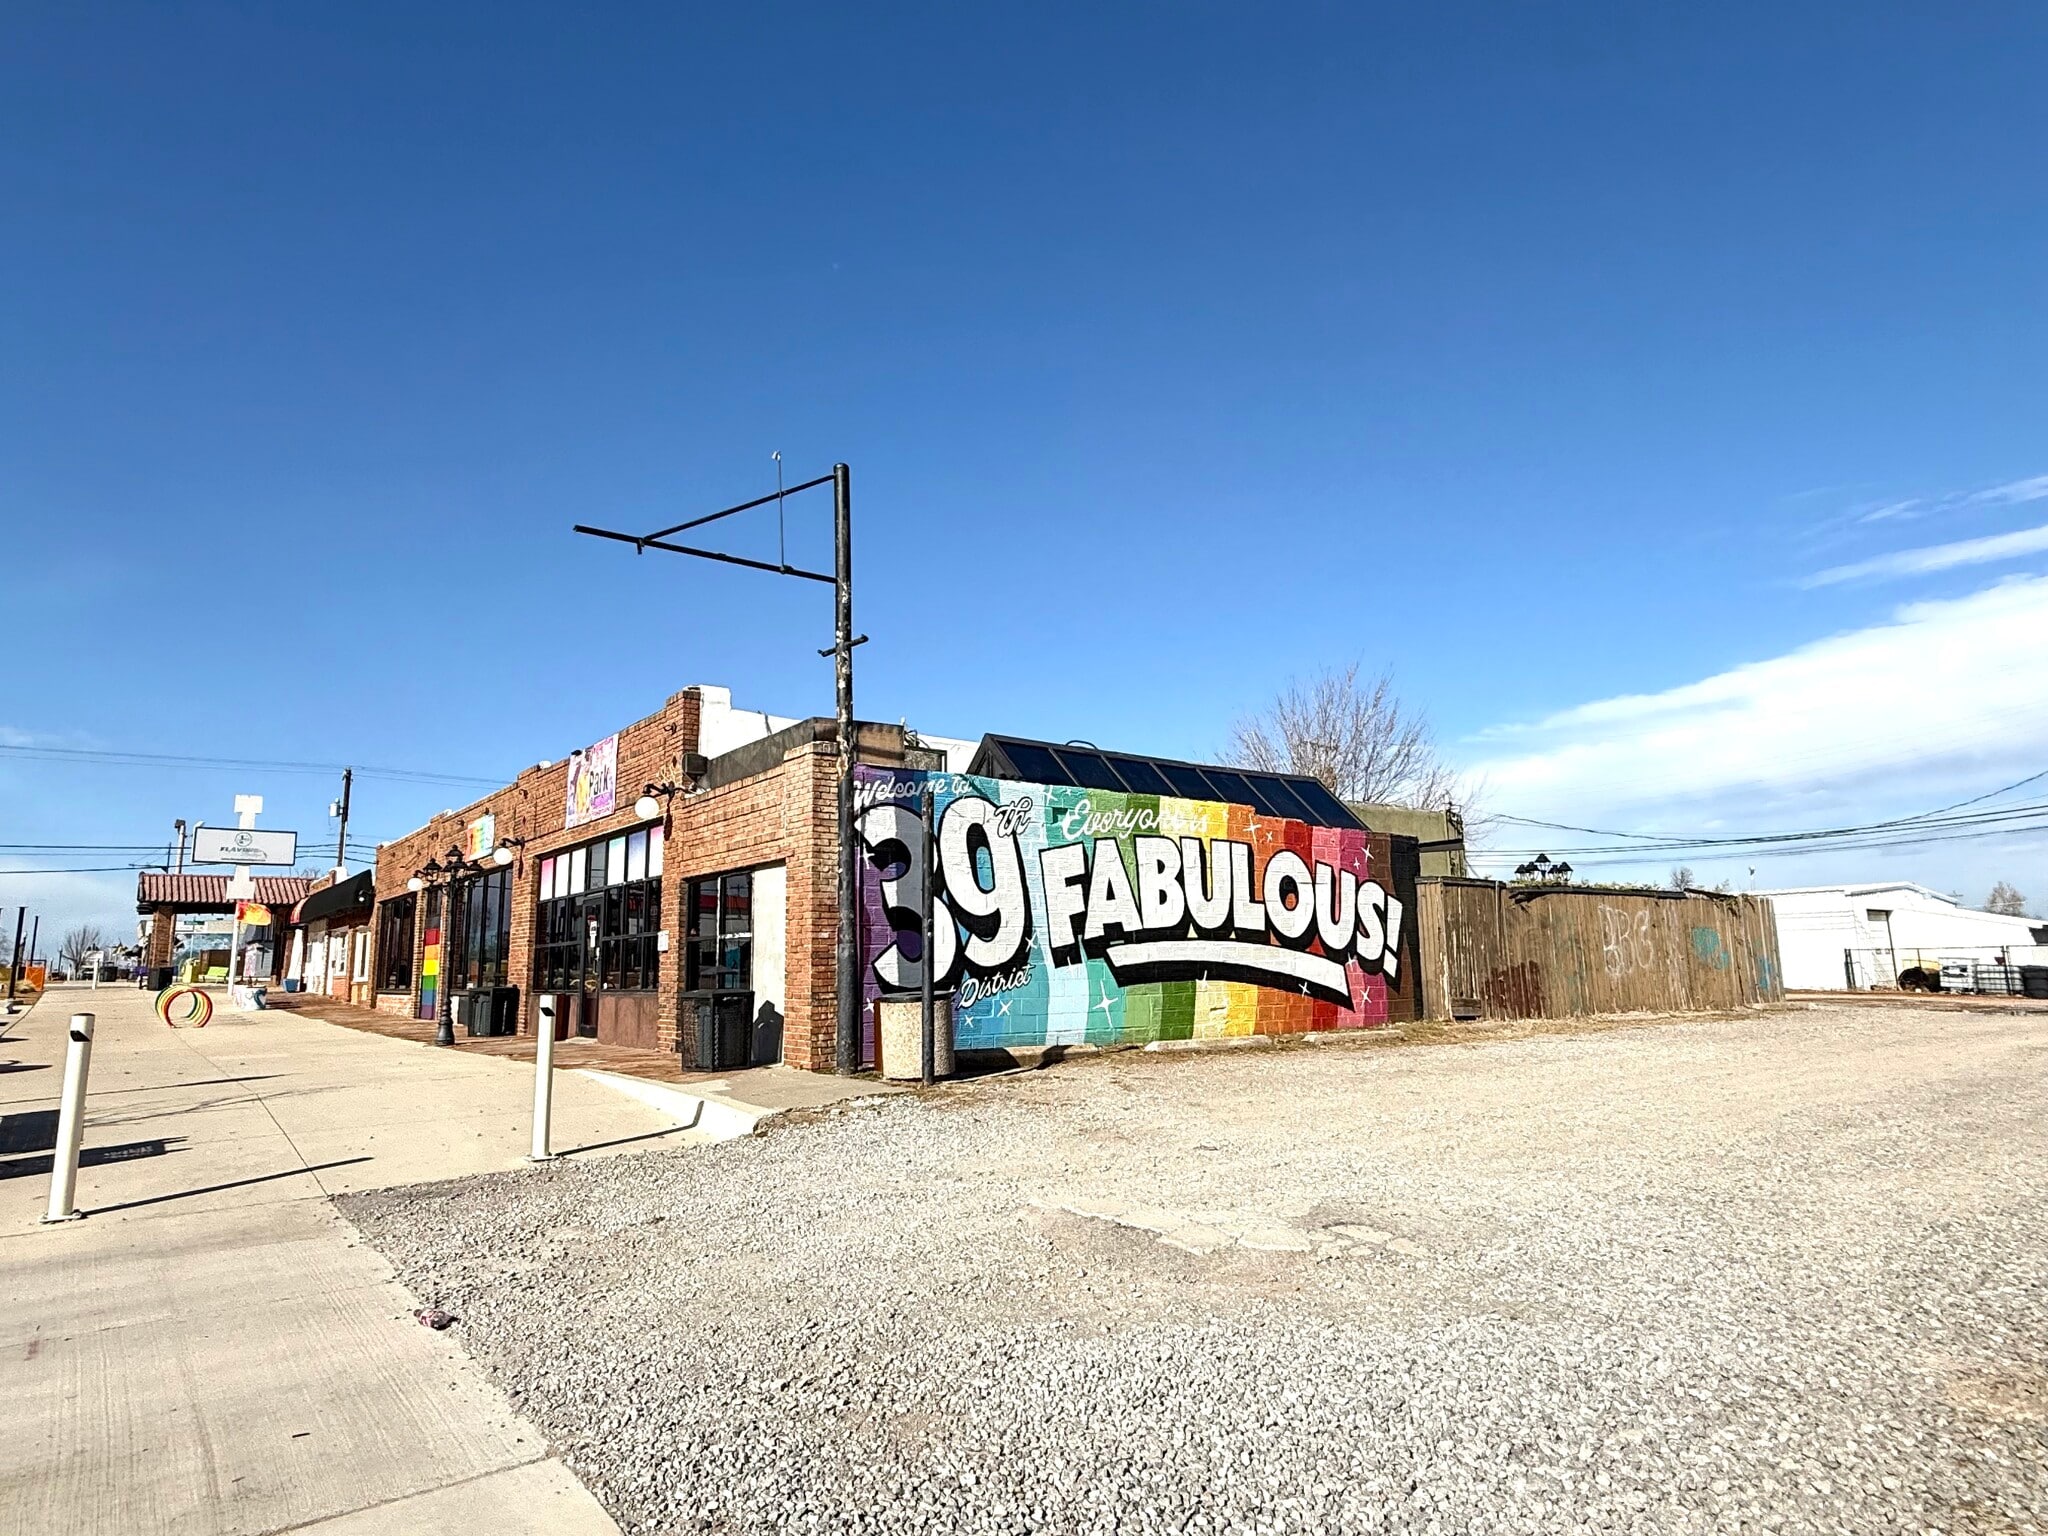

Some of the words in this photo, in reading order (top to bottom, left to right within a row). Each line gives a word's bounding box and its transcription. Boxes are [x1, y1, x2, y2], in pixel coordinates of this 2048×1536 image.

[588, 764, 610, 798] Park
[853, 776, 947, 808] Welcome
[951, 776, 974, 795] to
[1040, 836, 1403, 981] FABULOUS!
[958, 966, 1034, 1009] District
